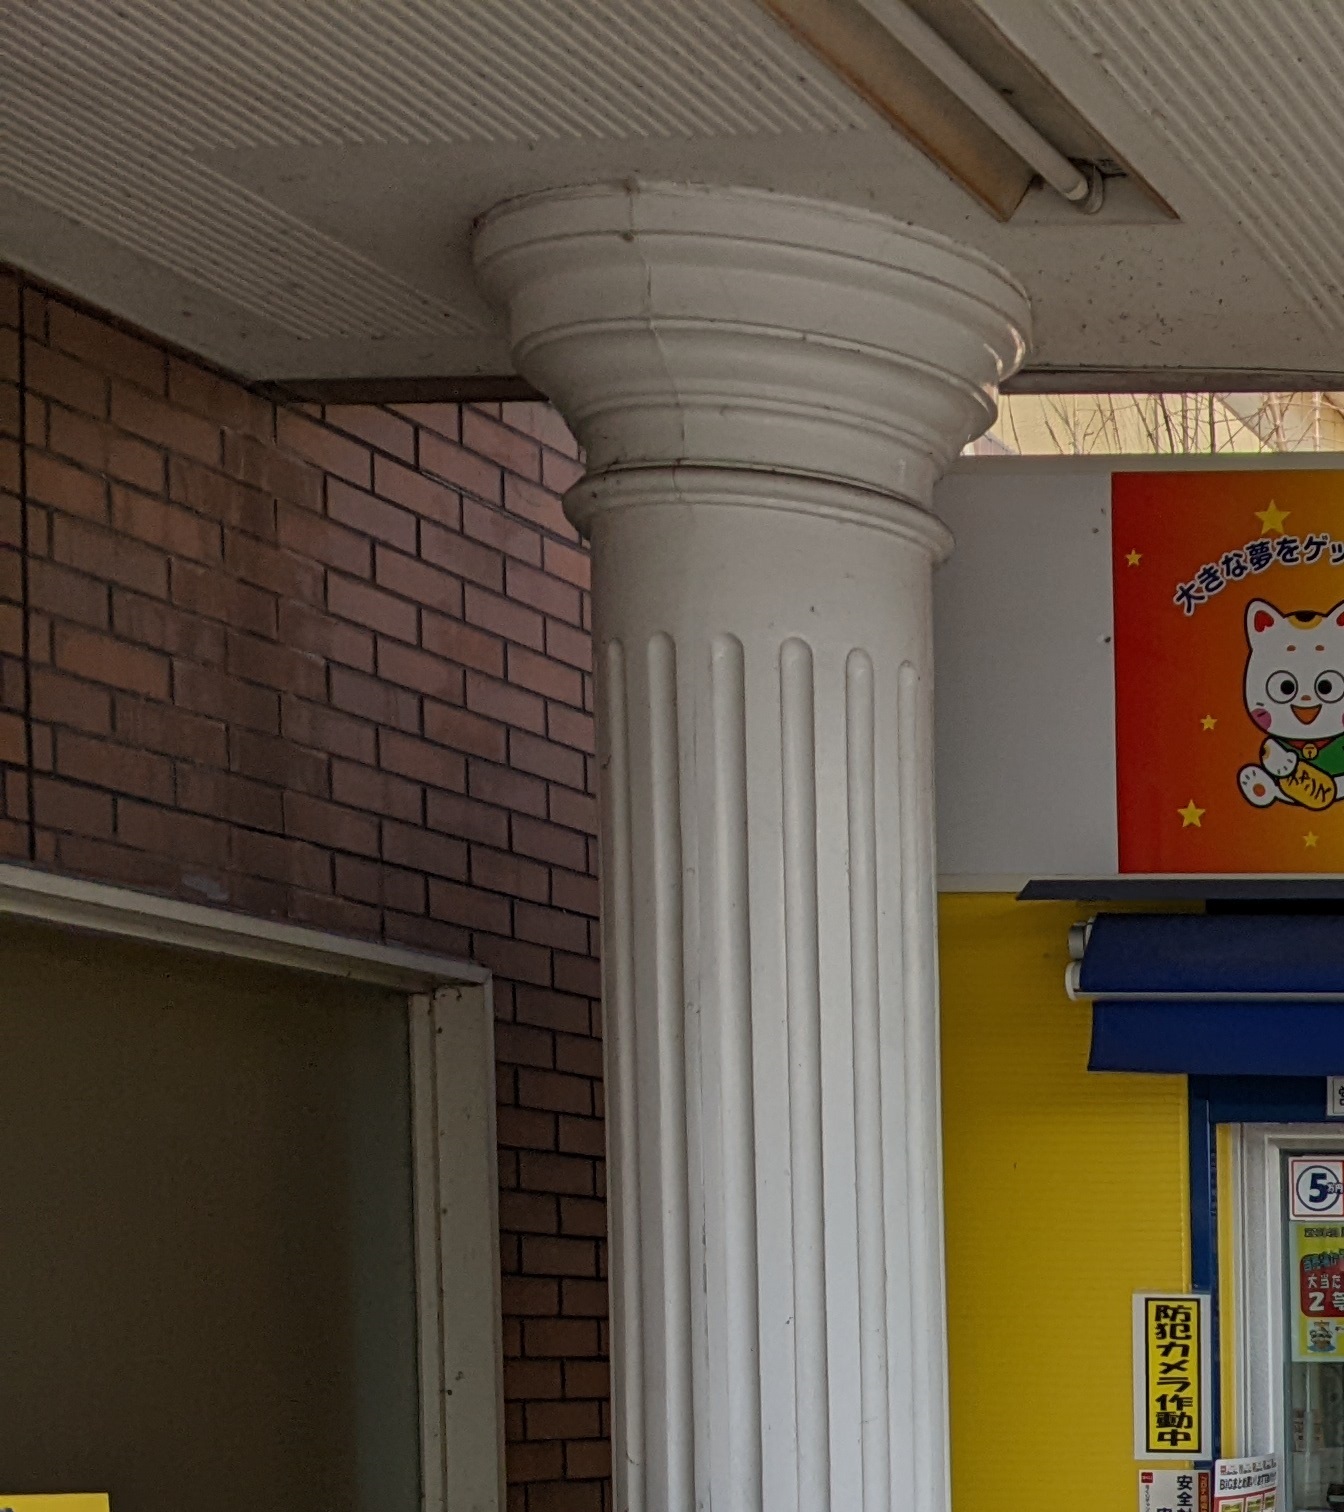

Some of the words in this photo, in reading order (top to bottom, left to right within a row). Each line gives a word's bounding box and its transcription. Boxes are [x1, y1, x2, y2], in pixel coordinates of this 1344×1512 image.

[1154, 1304, 1194, 1447] 防犯カメラ作動中
